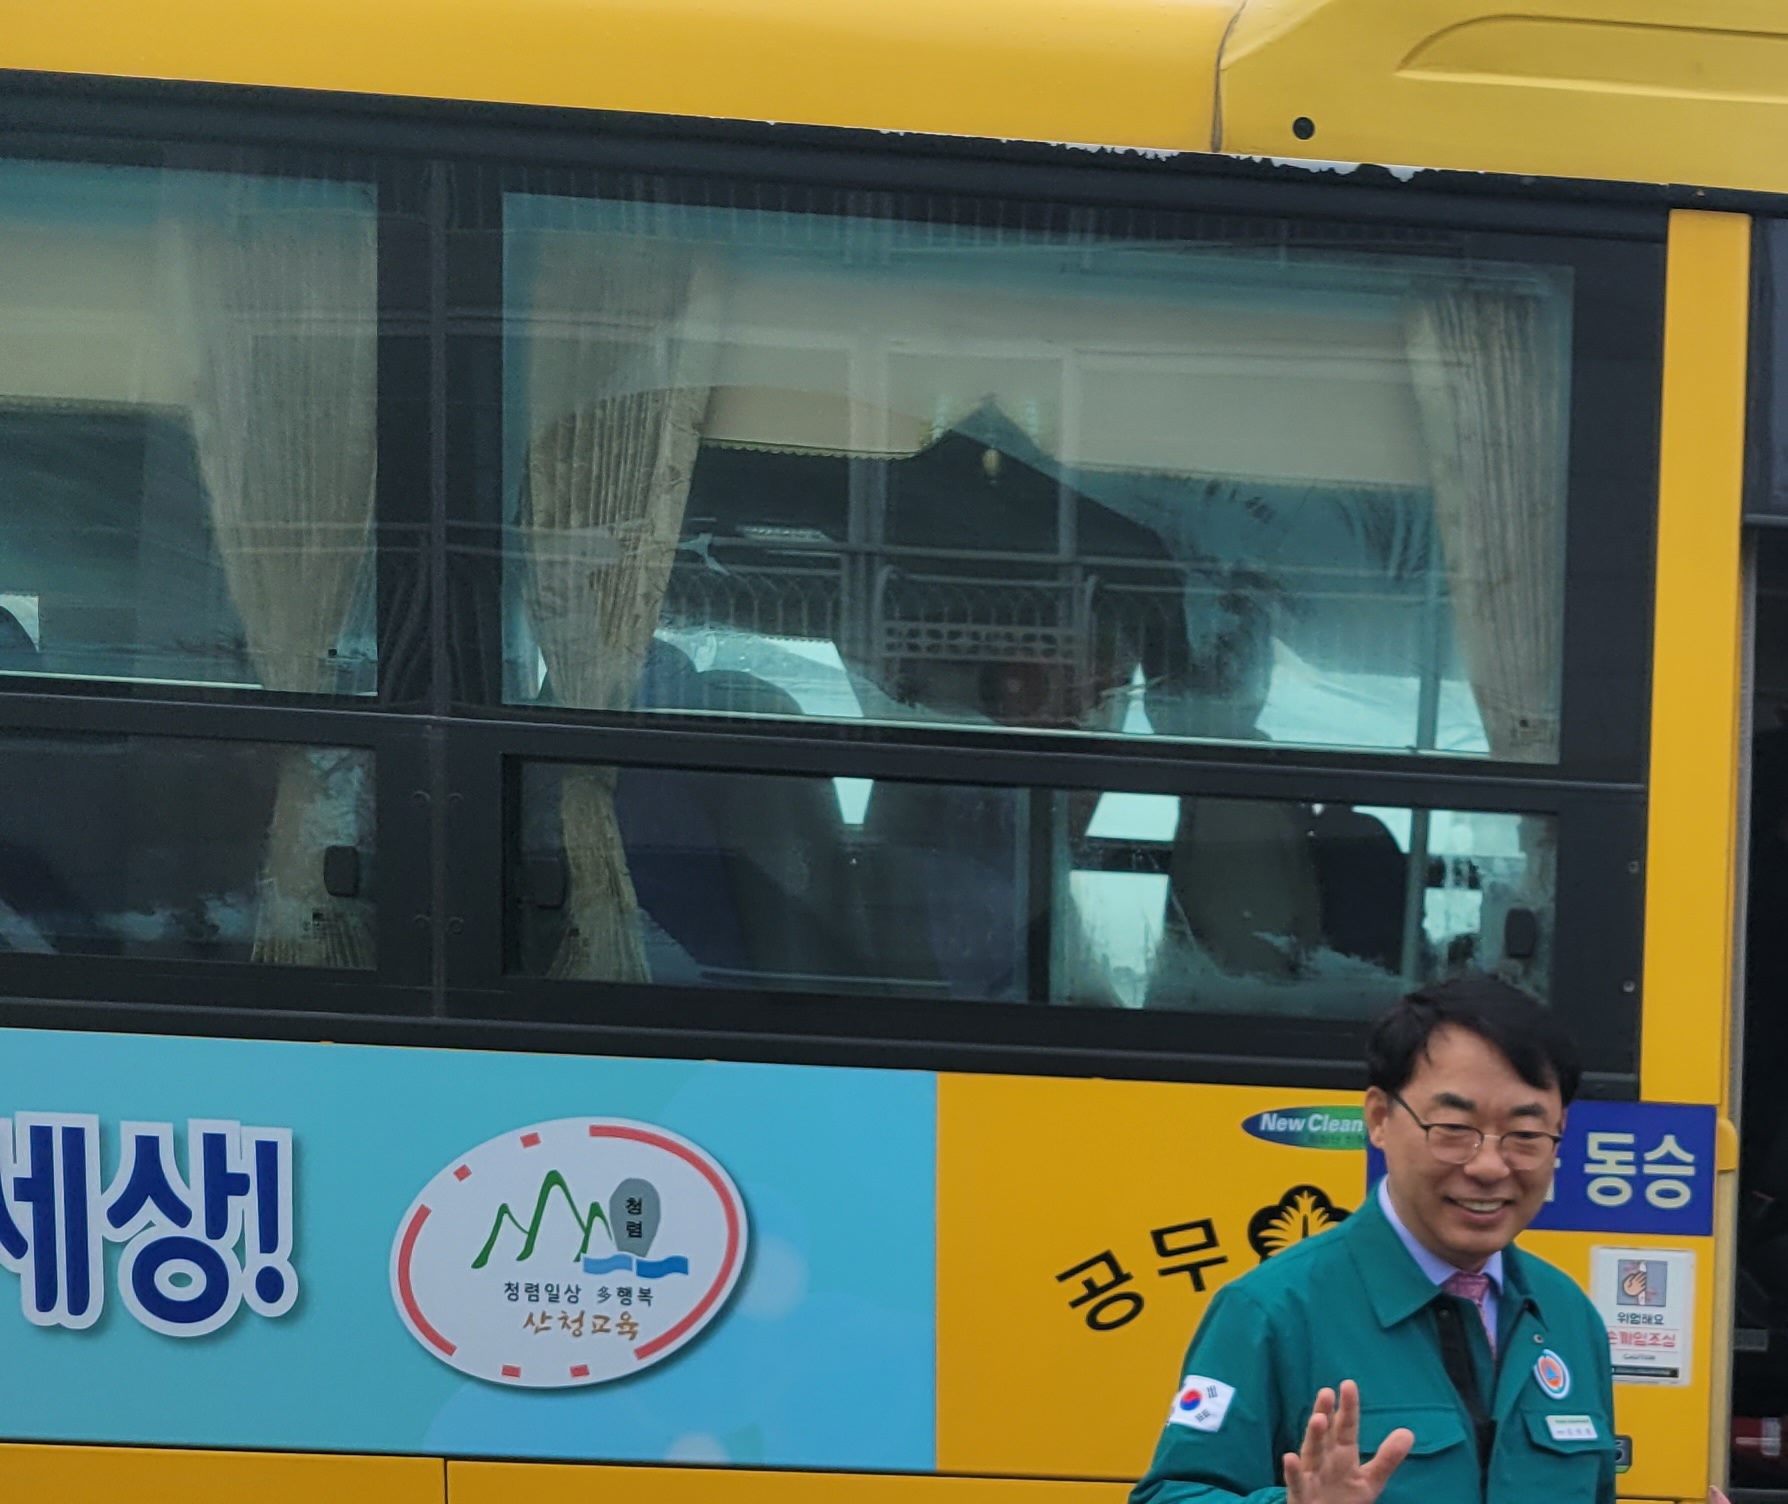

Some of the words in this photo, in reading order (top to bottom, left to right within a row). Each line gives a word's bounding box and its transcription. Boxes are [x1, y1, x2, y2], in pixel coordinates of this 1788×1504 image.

[1260, 1112, 1305, 1131] New
[1307, 1113, 1363, 1132] Clean
[1584, 1131, 1696, 1209] 동승
[0, 1115, 294, 1333] 세상!
[625, 1197, 643, 1239] 청렴
[1054, 1217, 1229, 1332] 공무
[504, 1281, 582, 1305] 청렴일상
[522, 1310, 640, 1341] 산청교육
[1617, 1312, 1665, 1326] 위험해요
